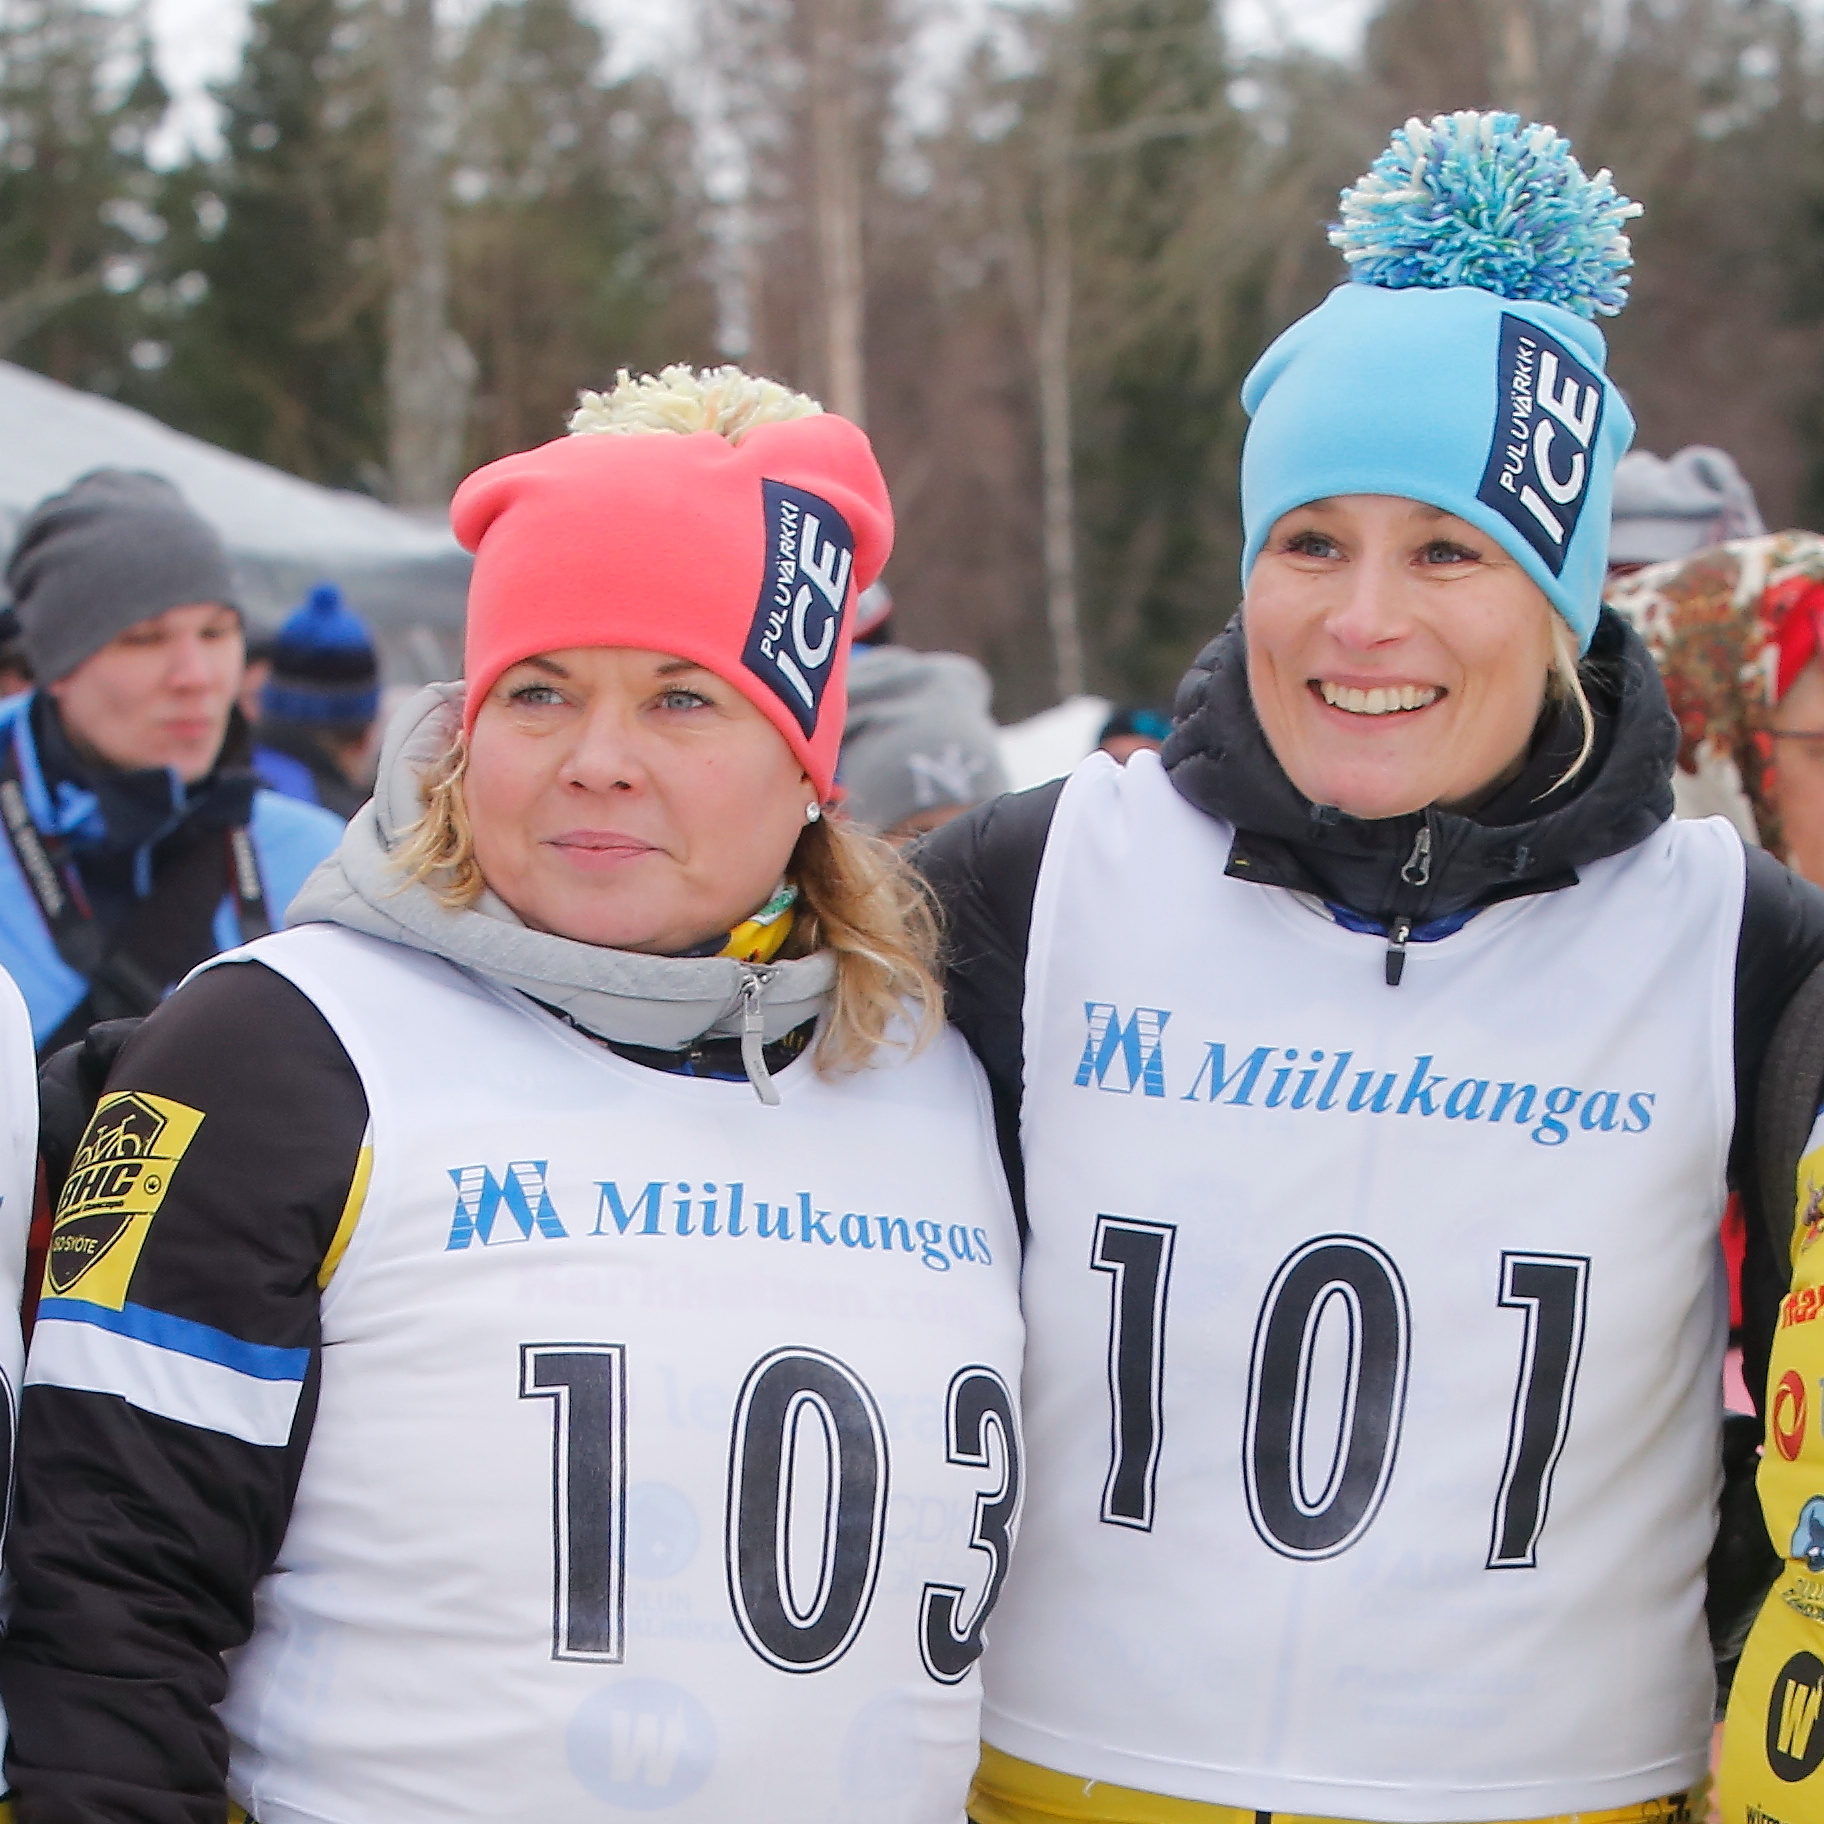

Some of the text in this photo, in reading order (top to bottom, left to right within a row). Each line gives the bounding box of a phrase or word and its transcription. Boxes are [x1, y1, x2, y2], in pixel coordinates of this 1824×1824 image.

[1499, 336, 1537, 494] PULUVÄRKKI
[1520, 350, 1599, 546] ICE
[760, 499, 801, 660] PULUVÄRKKI
[777, 512, 852, 709] ICE
[1180, 1040, 1656, 1147] Miilukangas
[587, 1180, 994, 1272] Miilukangas
[1089, 1212, 1592, 1570] 101
[518, 1341, 1022, 1686] 103
